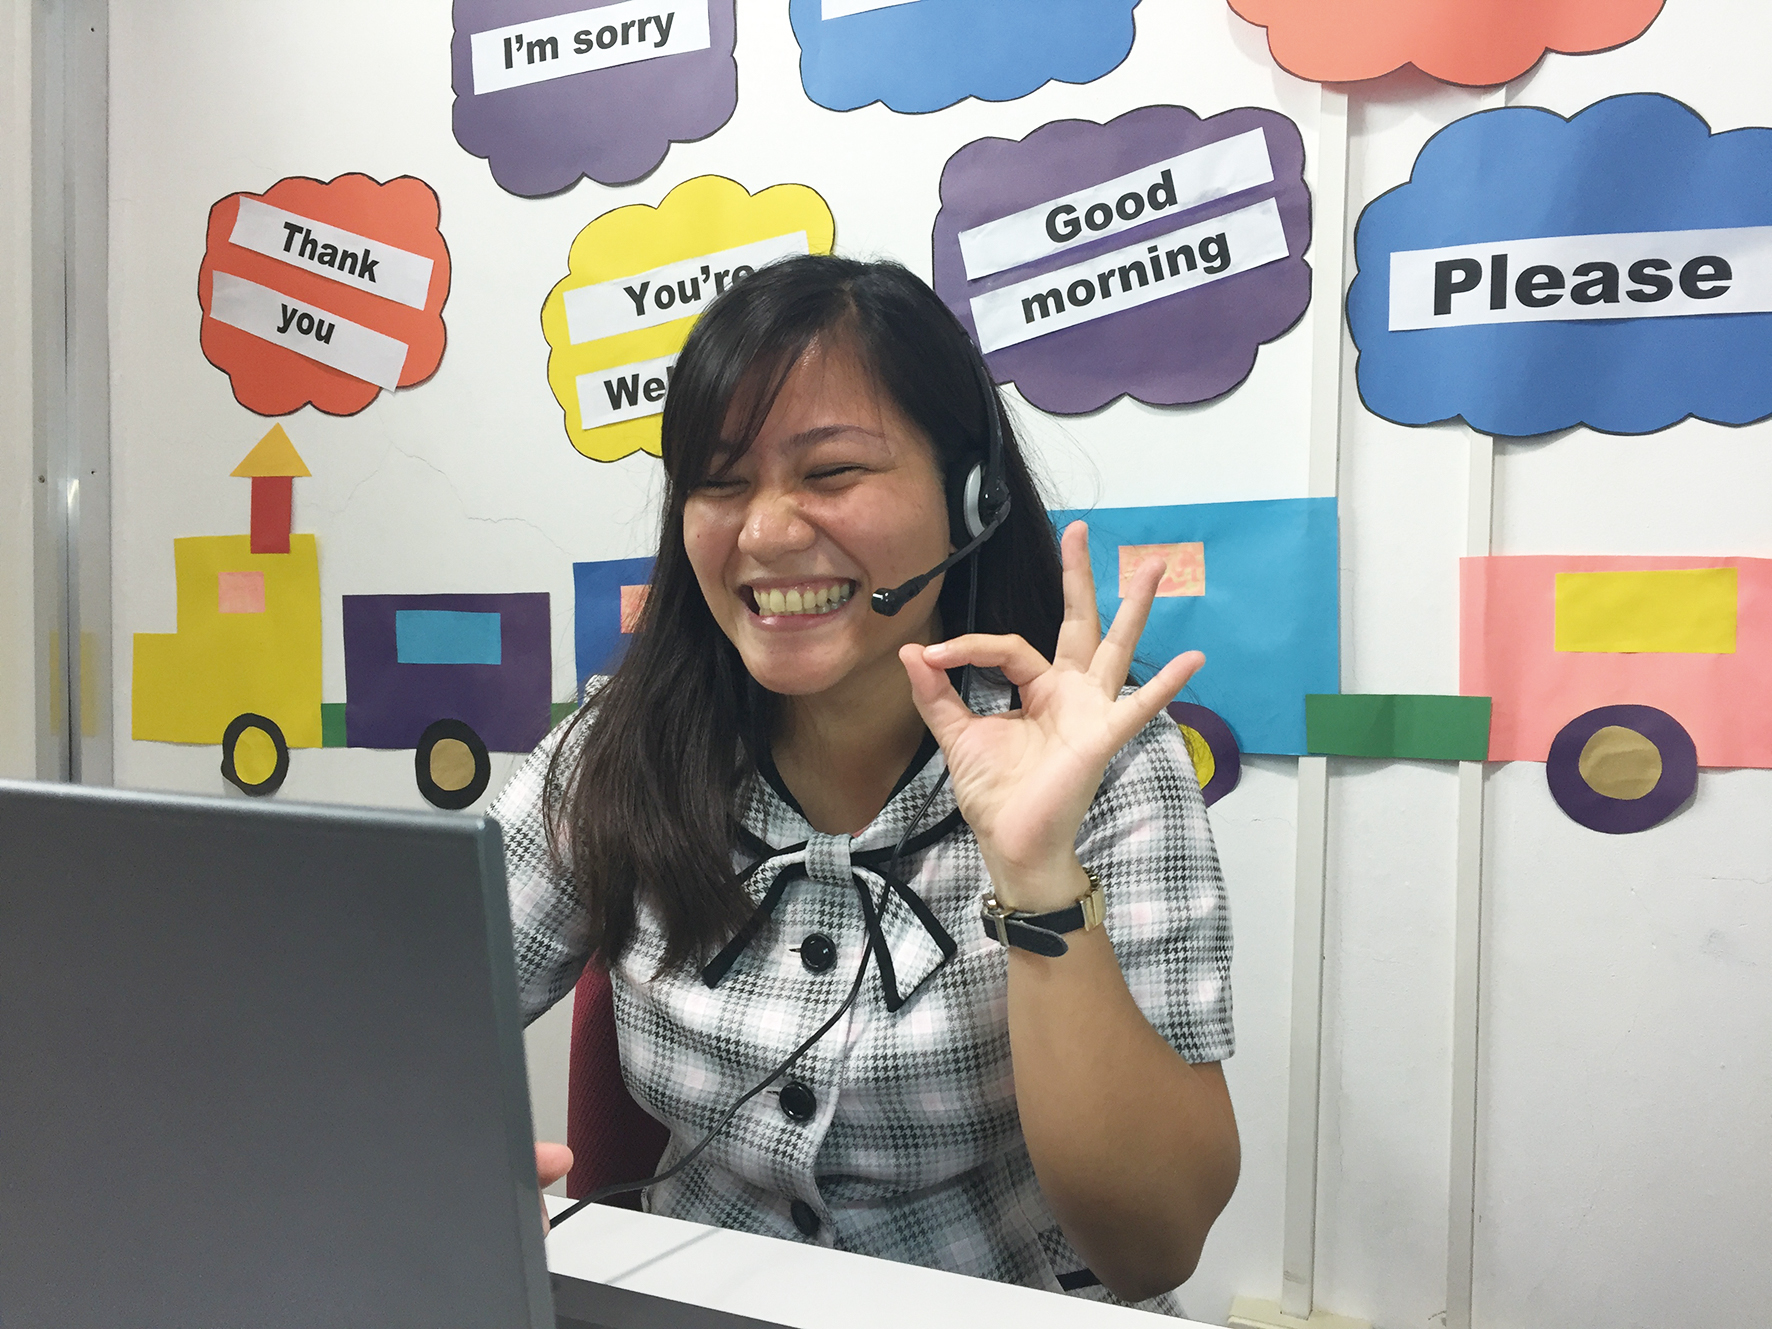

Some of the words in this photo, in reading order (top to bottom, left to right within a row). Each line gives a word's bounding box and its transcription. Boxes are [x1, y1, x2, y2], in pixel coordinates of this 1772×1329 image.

[503, 33, 559, 70] I'm
[573, 12, 675, 55] sorry
[1045, 168, 1178, 243] Good
[283, 221, 380, 283] Thank
[1021, 232, 1231, 324] morning
[1433, 253, 1733, 316] Please
[276, 303, 336, 345] you
